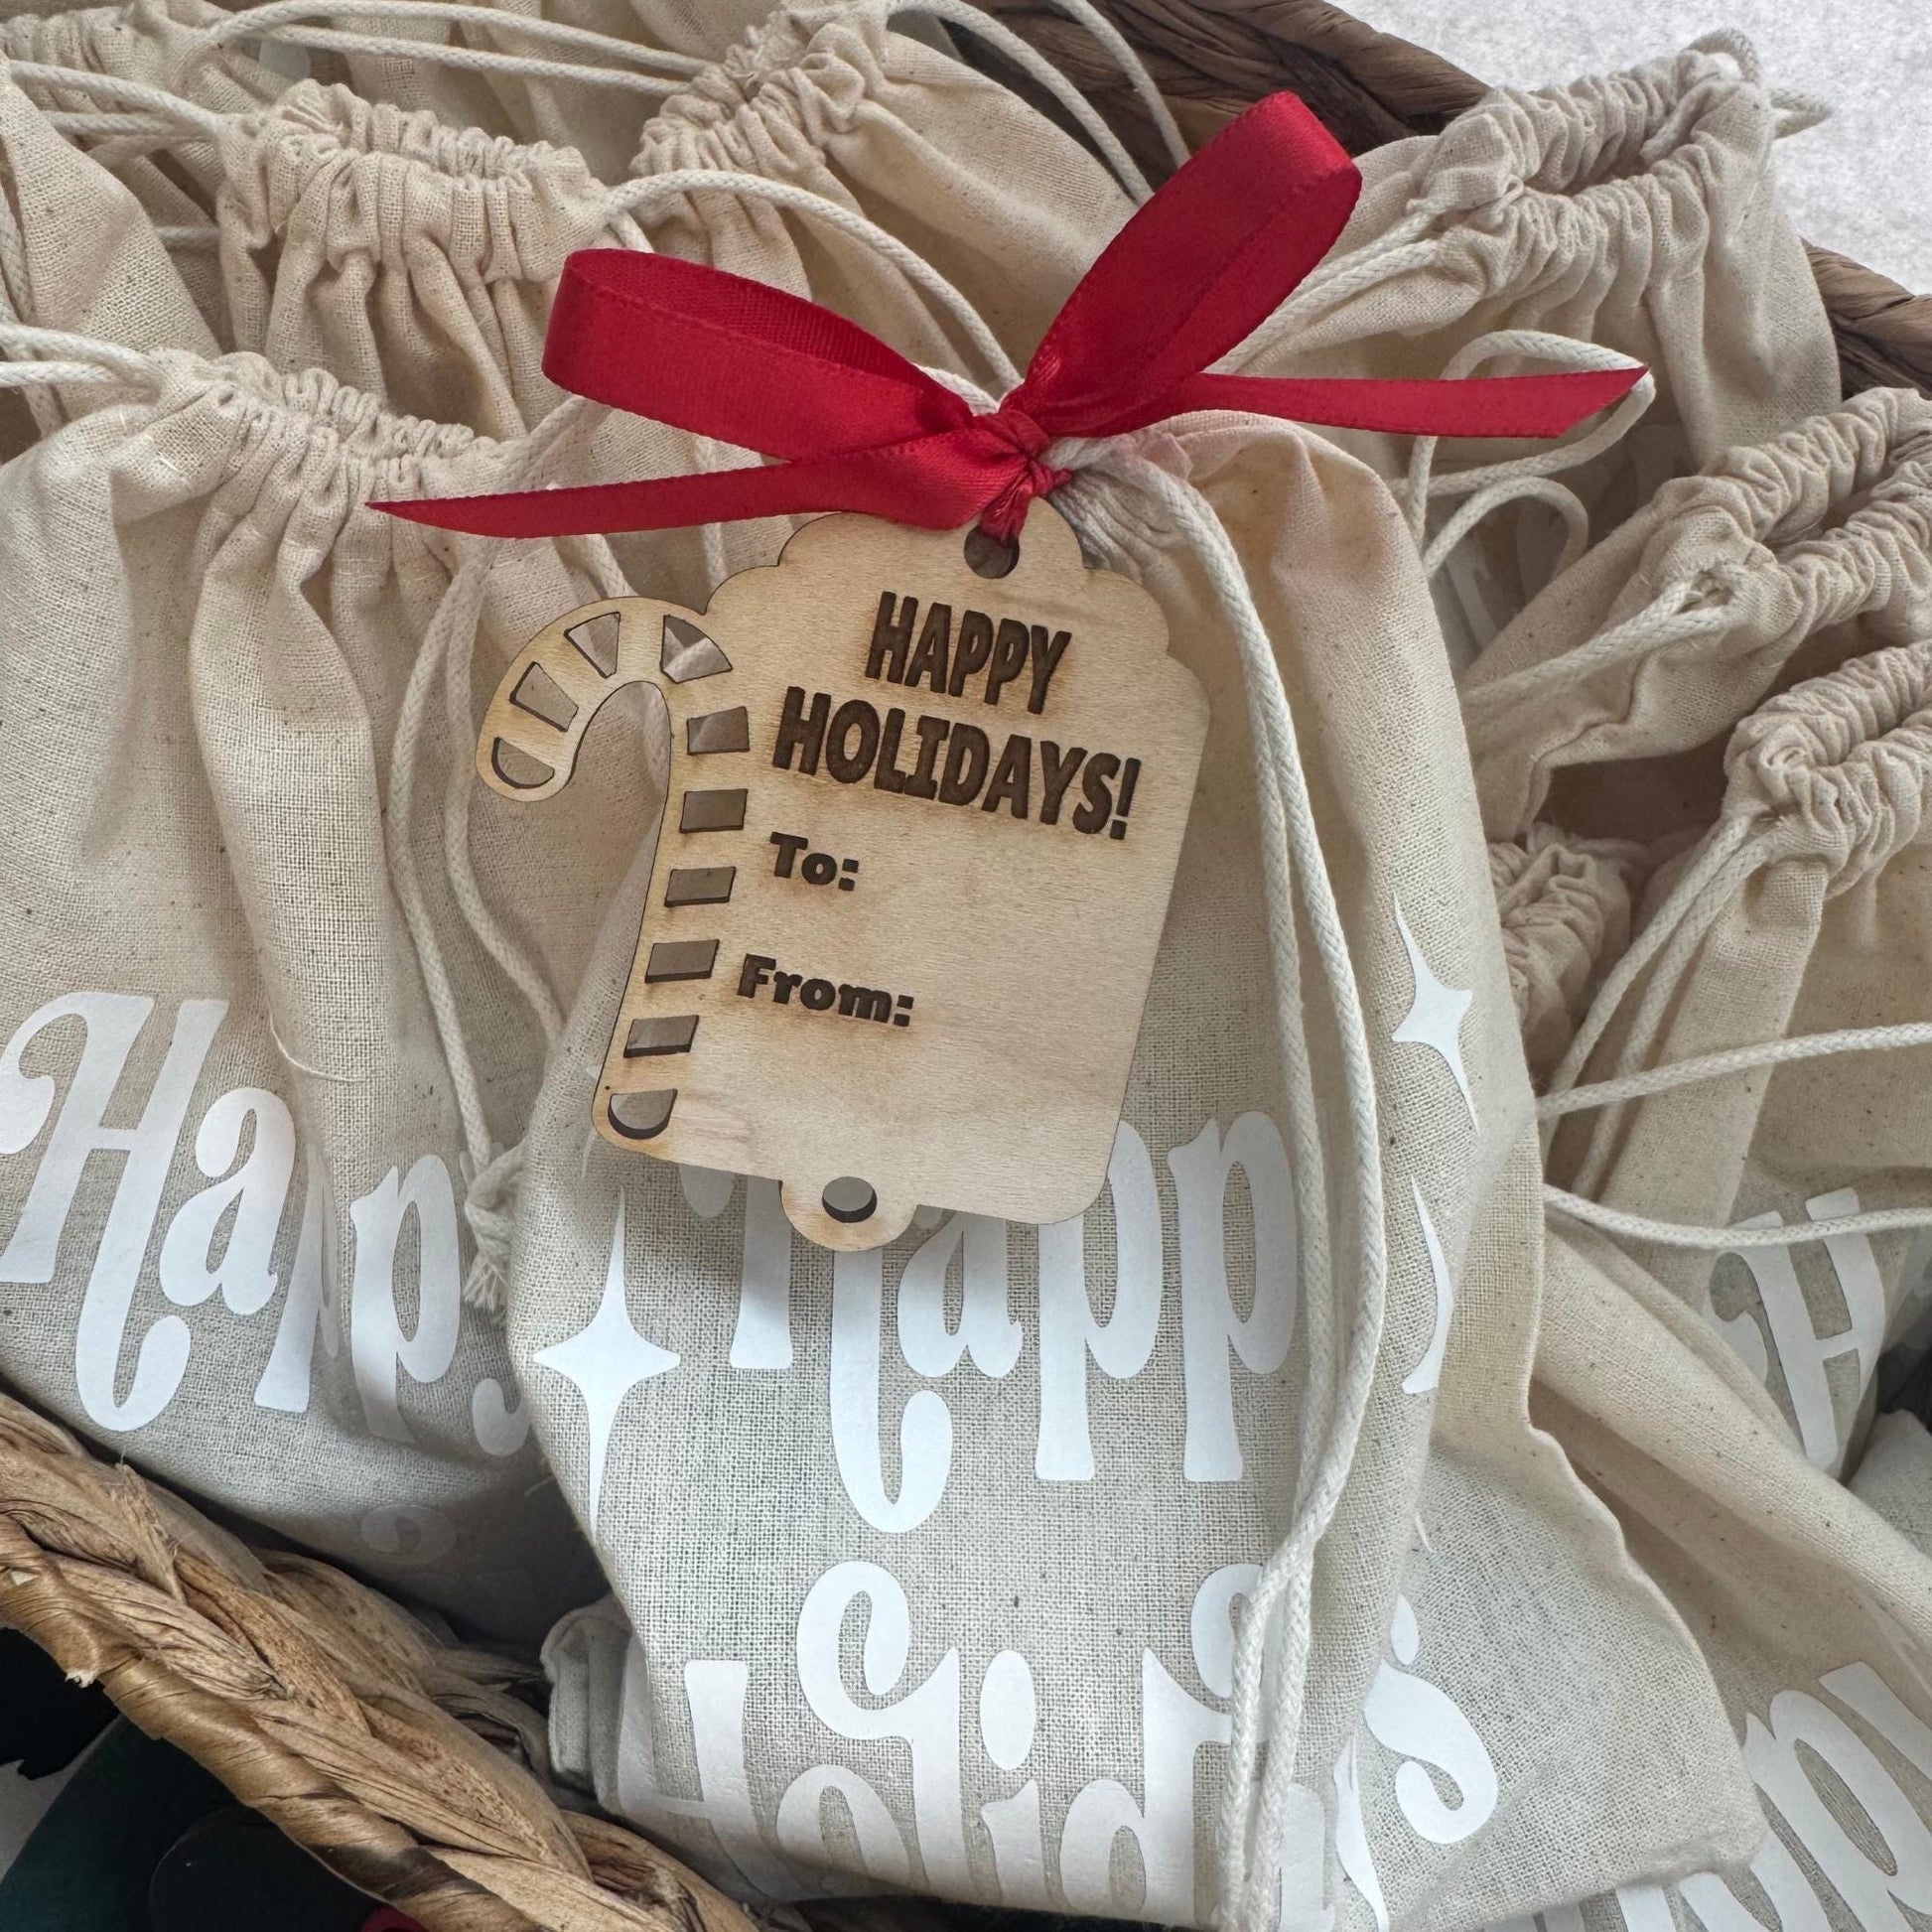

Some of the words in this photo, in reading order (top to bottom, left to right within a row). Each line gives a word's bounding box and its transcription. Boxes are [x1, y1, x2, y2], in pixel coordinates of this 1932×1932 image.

[865, 591, 1072, 715] HAPPY
[772, 686, 1142, 841] HOLIDAYS!
[769, 831, 860, 892] To:
[737, 952, 914, 1028] From:
